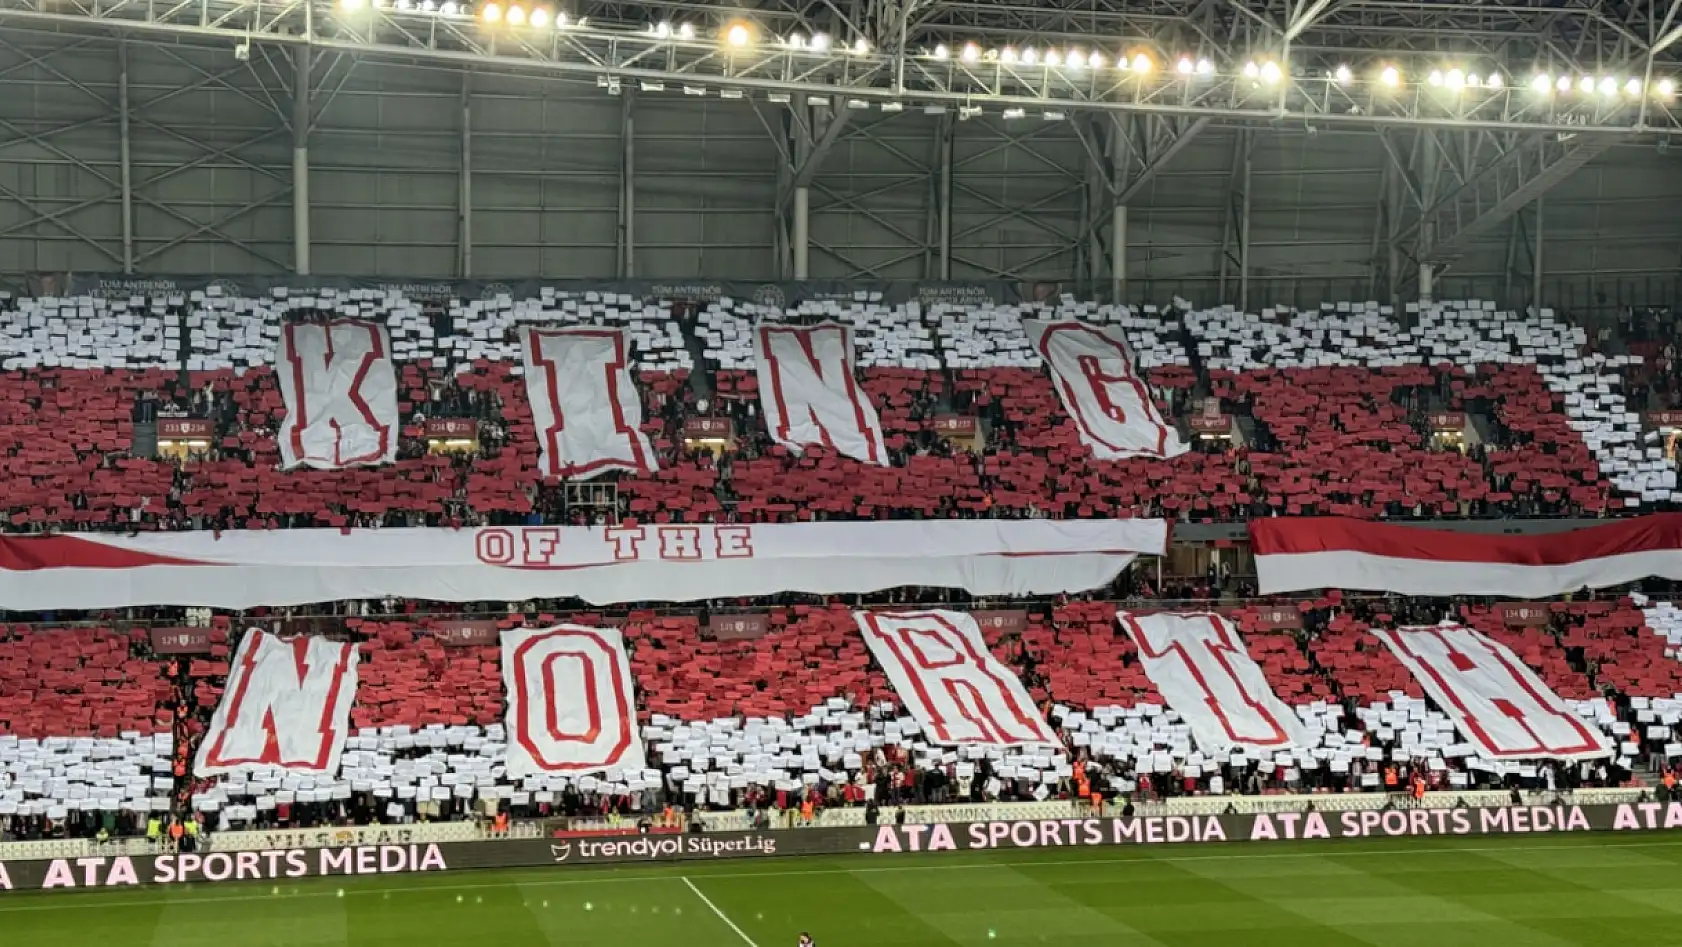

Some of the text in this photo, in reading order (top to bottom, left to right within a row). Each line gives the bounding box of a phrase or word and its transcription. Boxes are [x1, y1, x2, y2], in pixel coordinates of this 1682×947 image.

[284, 318, 1168, 477] KING
[475, 525, 753, 565] OF THE
[204, 610, 1600, 770] NORTH
[873, 815, 1227, 853] ATA SPORTS MEDIA
[1250, 804, 1591, 840] ATA SPORTS MEDIA
[42, 856, 139, 888] ATA
[153, 848, 308, 883] SPORTS
[319, 843, 447, 876] MEDIA
[578, 834, 776, 858] trendyol SüperLig
